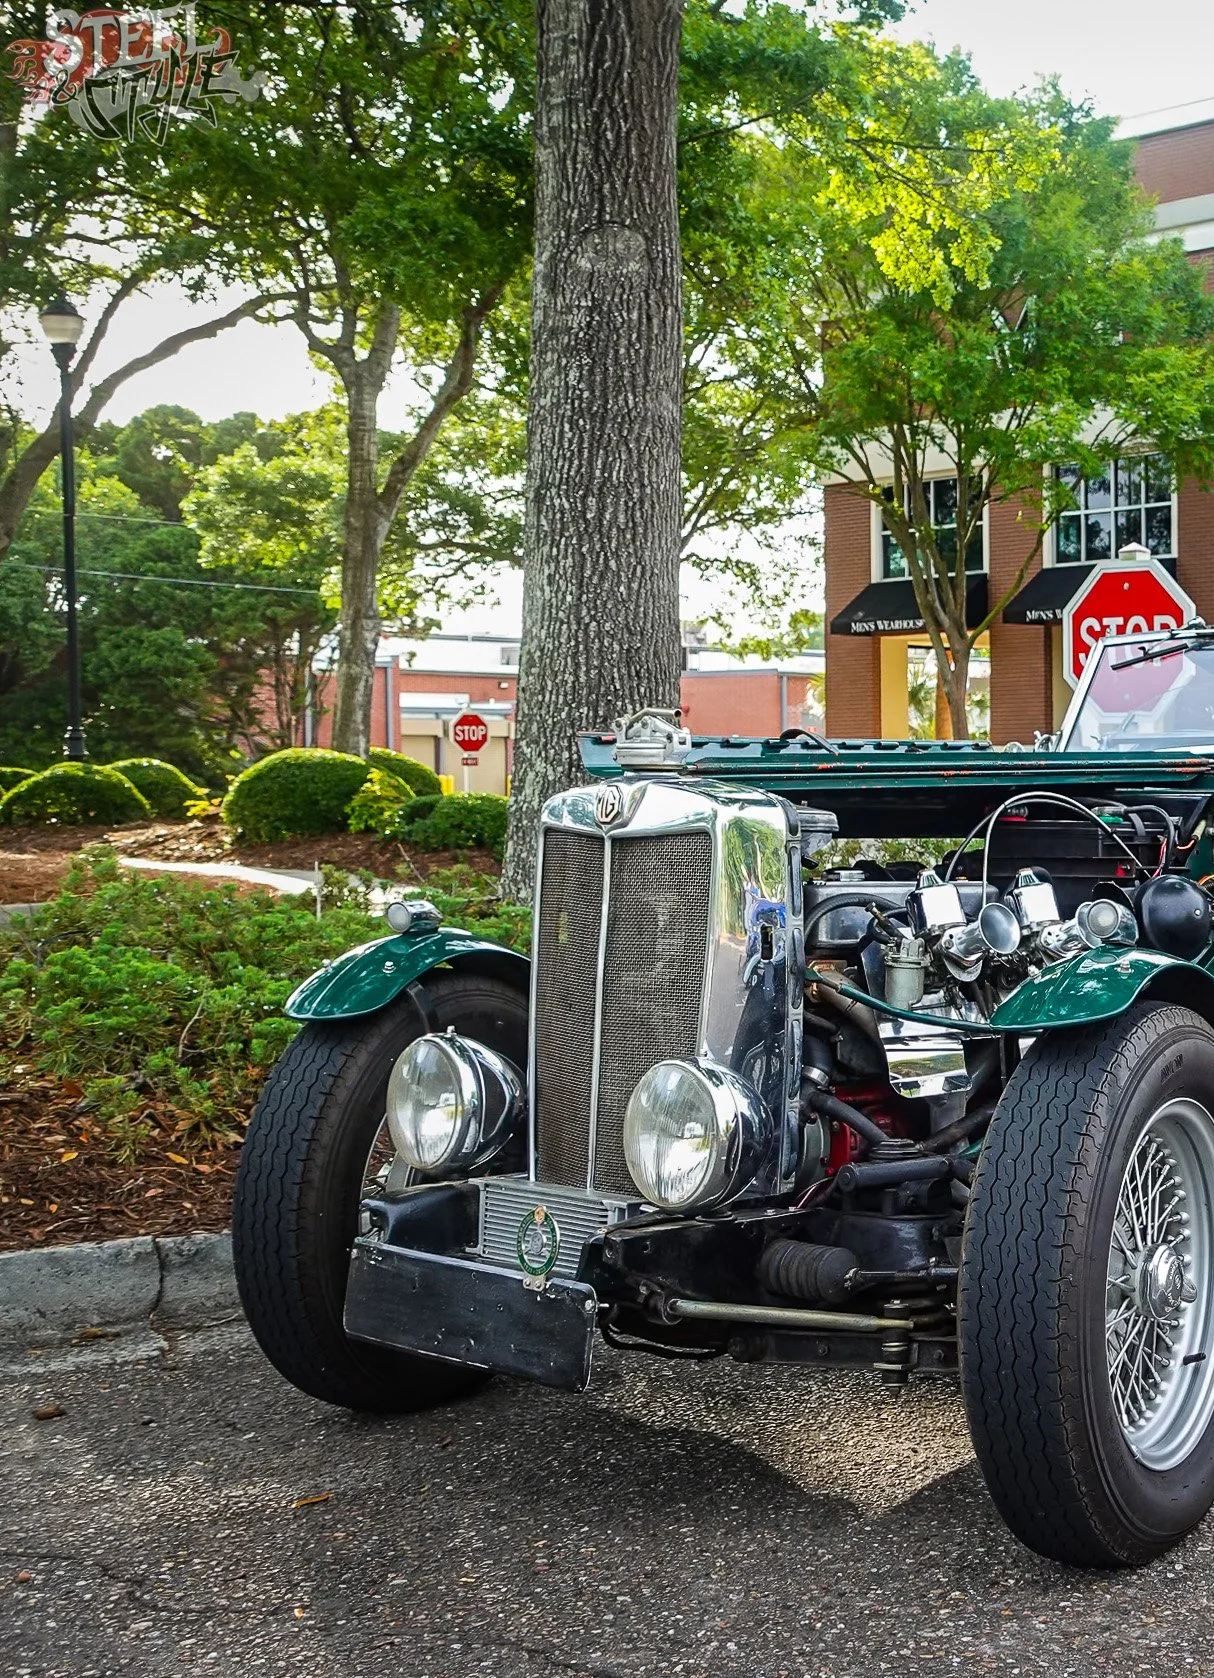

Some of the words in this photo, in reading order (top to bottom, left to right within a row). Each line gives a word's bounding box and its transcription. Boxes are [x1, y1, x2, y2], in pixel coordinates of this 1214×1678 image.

[876, 619, 926, 631] WEARHOUS
[1079, 614, 1179, 668] STOP
[455, 725, 487, 741] STOP
